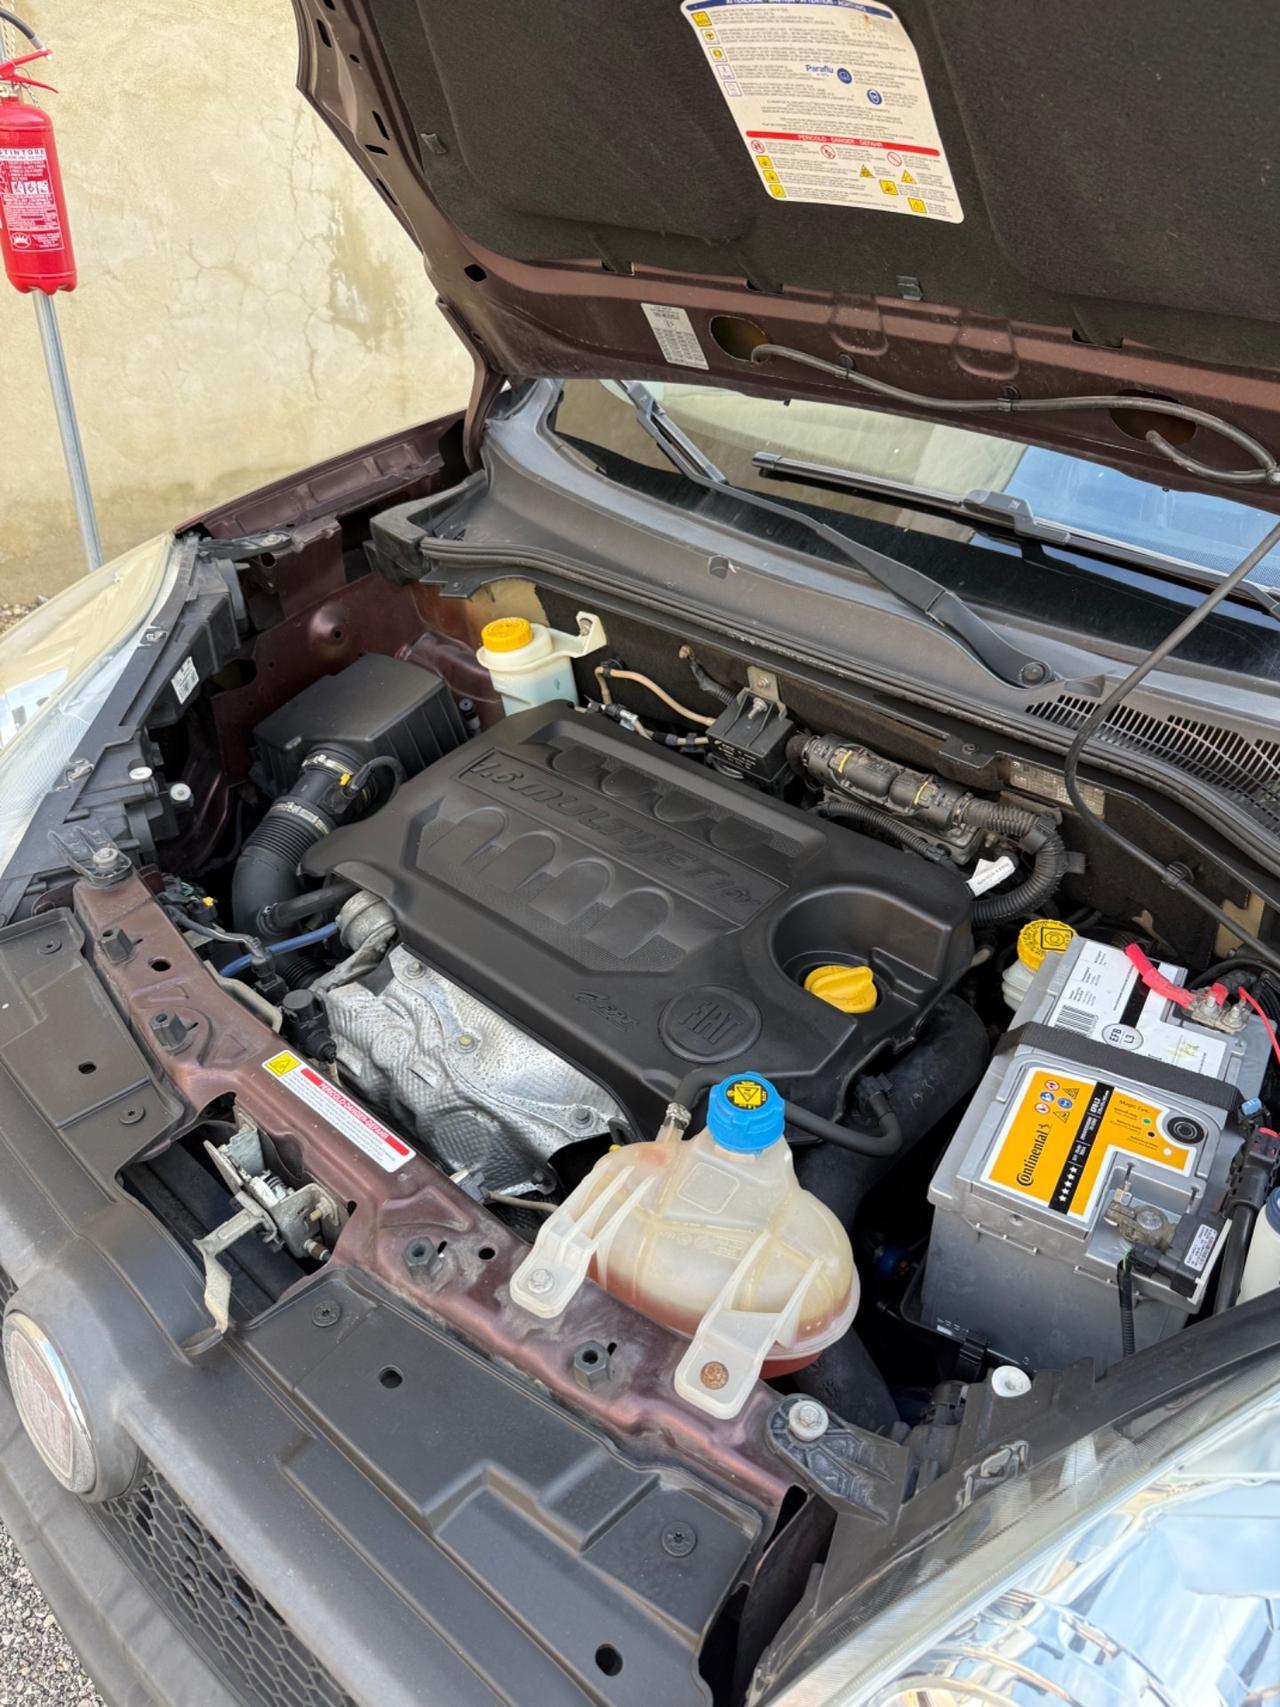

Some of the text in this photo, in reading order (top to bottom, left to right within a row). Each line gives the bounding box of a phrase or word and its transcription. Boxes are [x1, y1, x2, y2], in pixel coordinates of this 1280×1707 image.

[805, 64, 834, 74] Paraflu
[678, 1001, 745, 1045] FIAT
[1109, 1027, 1122, 1043] EFB
[1016, 1129, 1049, 1186] Continental
